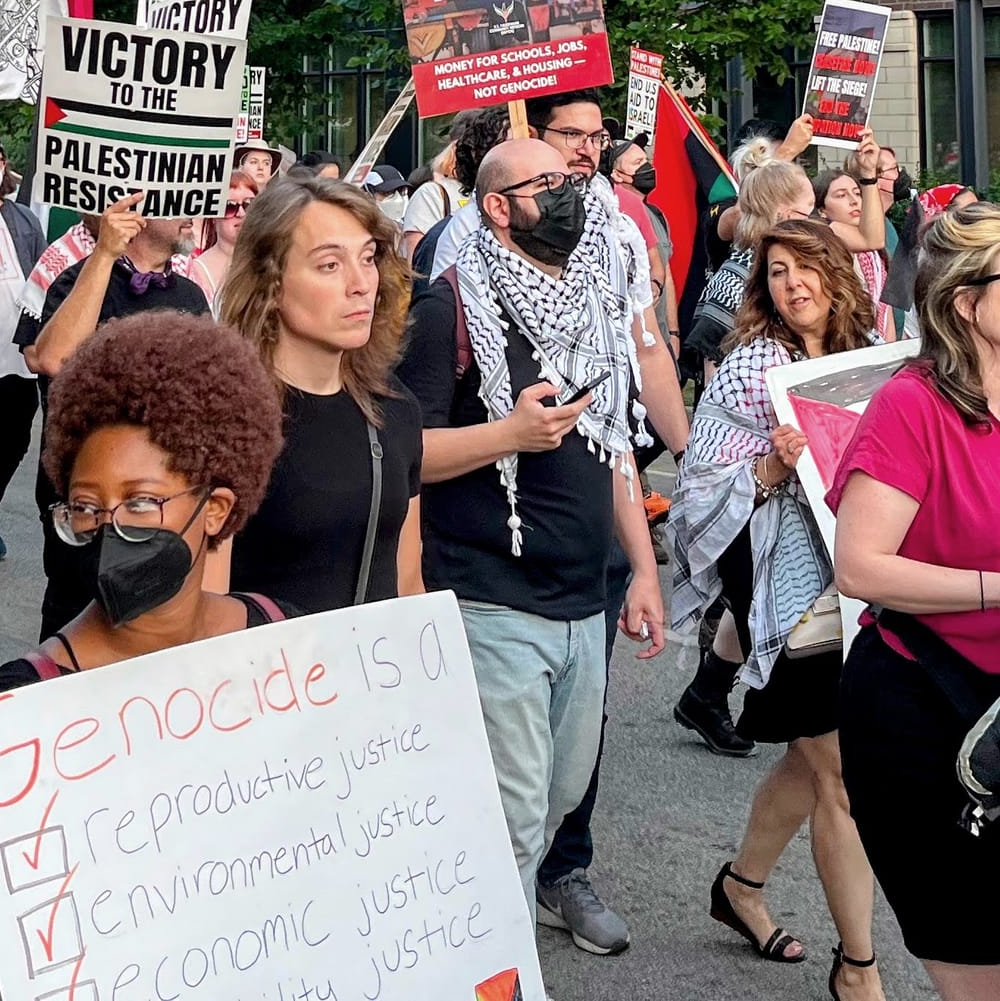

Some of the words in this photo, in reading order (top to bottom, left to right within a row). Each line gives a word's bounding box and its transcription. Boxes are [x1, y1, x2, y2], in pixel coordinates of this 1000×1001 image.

[61, 25, 236, 90] VICTORY
[434, 58, 474, 75] MONEY
[476, 54, 498, 68] FOR
[501, 45, 555, 64] SCHOOLS,
[556, 40, 587, 54] JOBS,
[820, 30, 839, 48] FREE
[837, 33, 881, 55] PALESTINE!
[437, 69, 511, 90] HEALTHCARE,
[512, 66, 522, 77] &
[523, 57, 573, 75] HOUSING
[474, 85, 497, 99] NOT
[499, 75, 558, 94] GENOCIDE!
[630, 76, 643, 91] END
[811, 75, 827, 91] LIFT
[827, 77, 842, 93] THE
[841, 79, 868, 98] SIEGE!
[110, 81, 134, 106] TO
[141, 86, 178, 111] THE
[629, 91, 641, 107] AID
[644, 95, 655, 111] TO
[628, 108, 654, 126] ISRAEL!
[45, 135, 226, 184] PALESTINIAN
[42, 172, 222, 217] RESISTANCE
[352, 627, 402, 692] is
[419, 618, 448, 681] a
[84, 756, 326, 864] reproductive
[336, 723, 430, 800] justice
[91, 812, 347, 935] environmental
[355, 794, 446, 858] justice
[111, 900, 331, 1001] economic
[357, 850, 476, 937] justice
[363, 901, 493, 1001] justice
